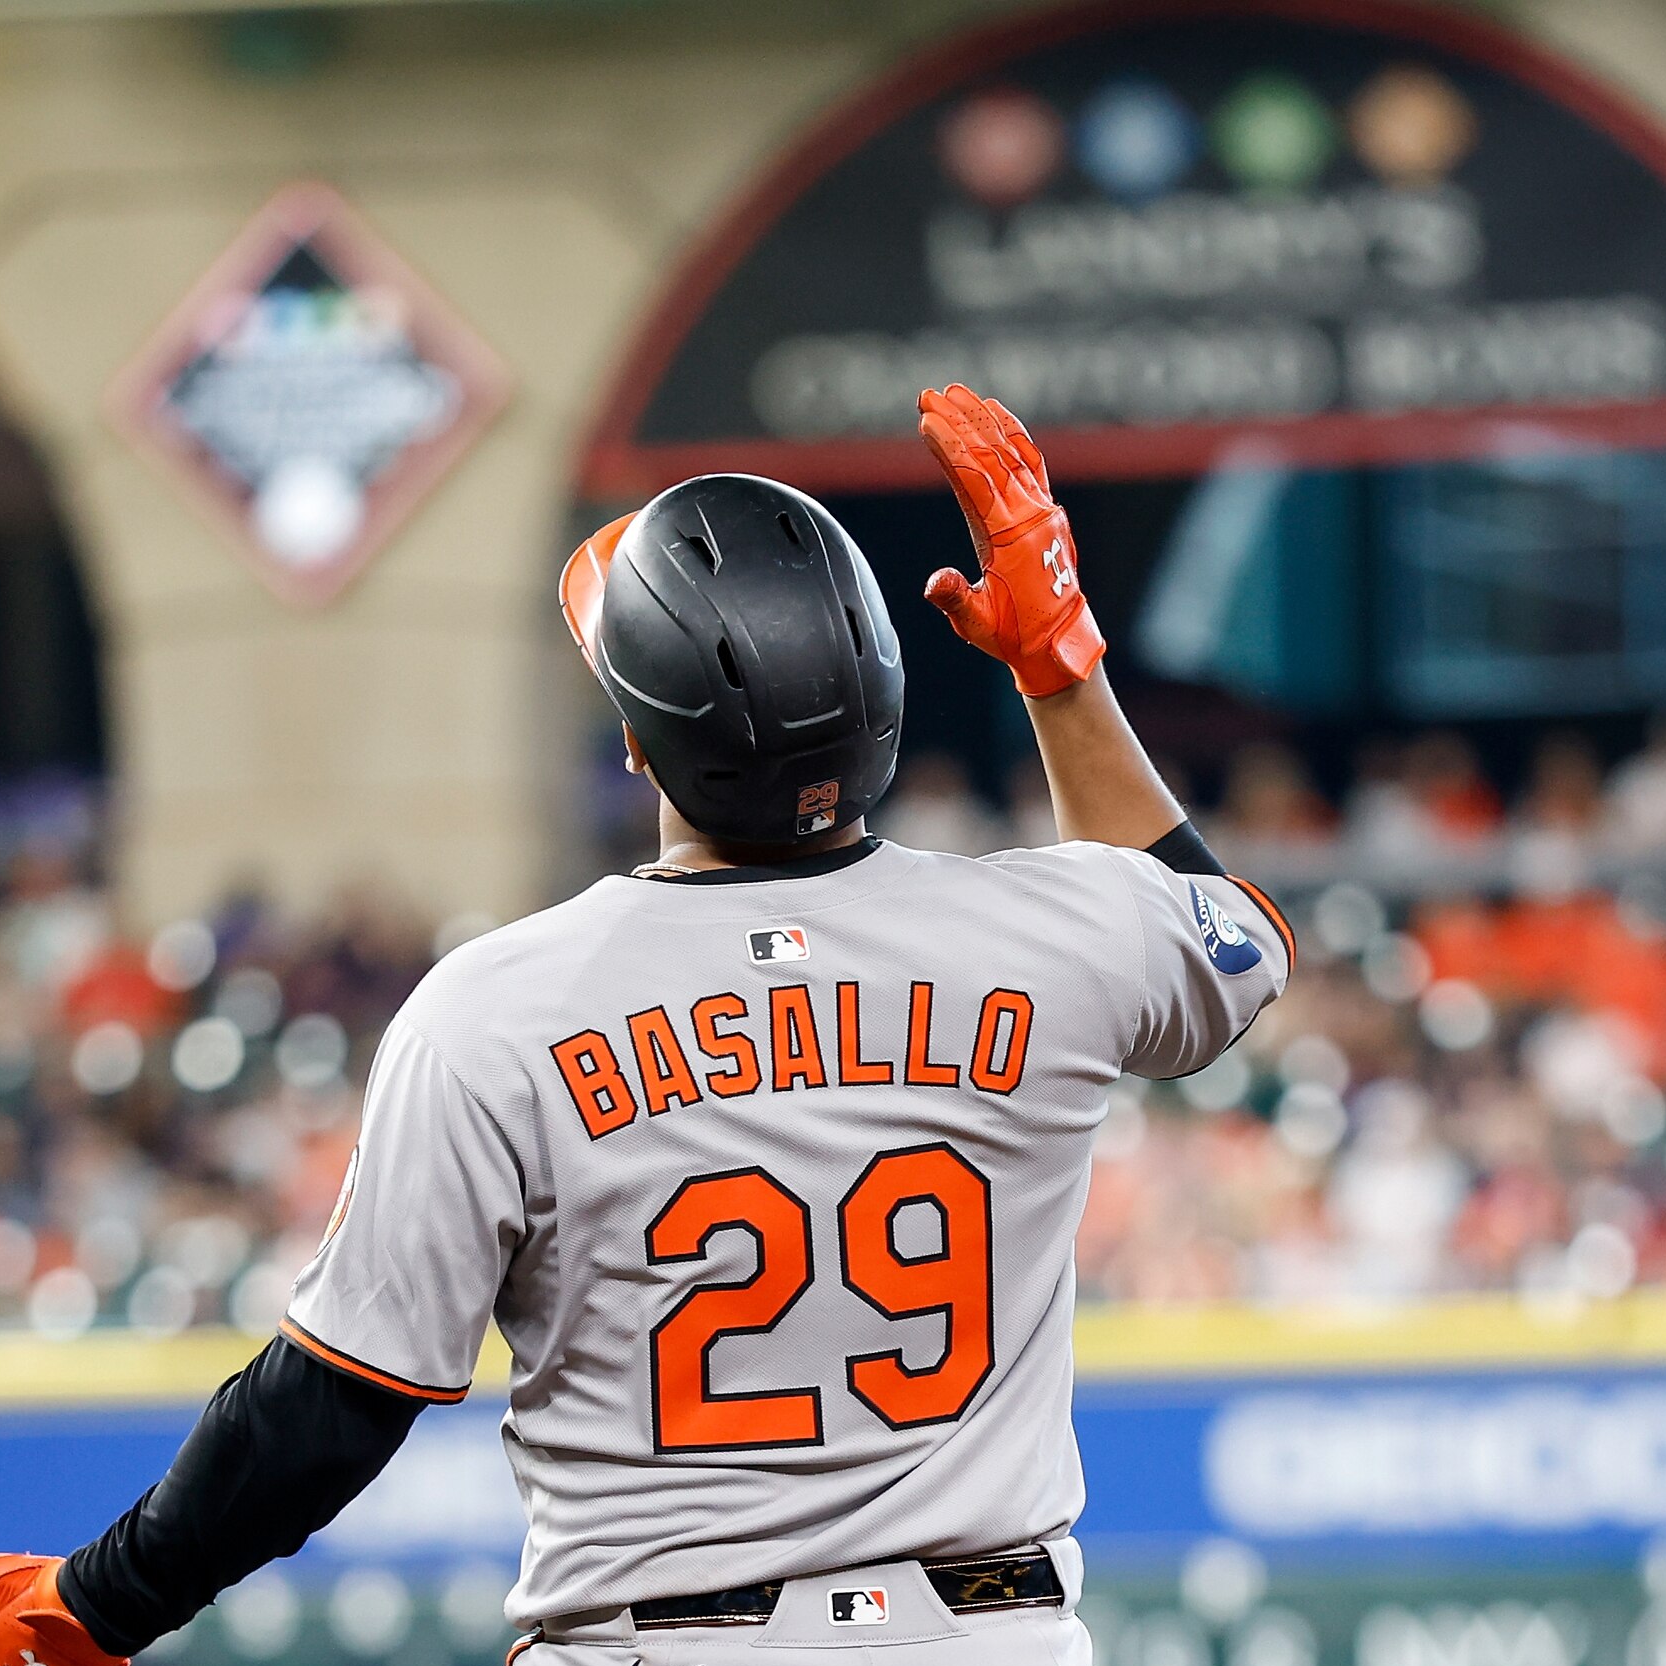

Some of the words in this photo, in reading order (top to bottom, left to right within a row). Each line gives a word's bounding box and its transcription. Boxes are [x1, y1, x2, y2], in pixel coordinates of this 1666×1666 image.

[798, 781, 839, 815] 29
[549, 980, 1035, 1141] BASALLO
[645, 1141, 996, 1455] 29
